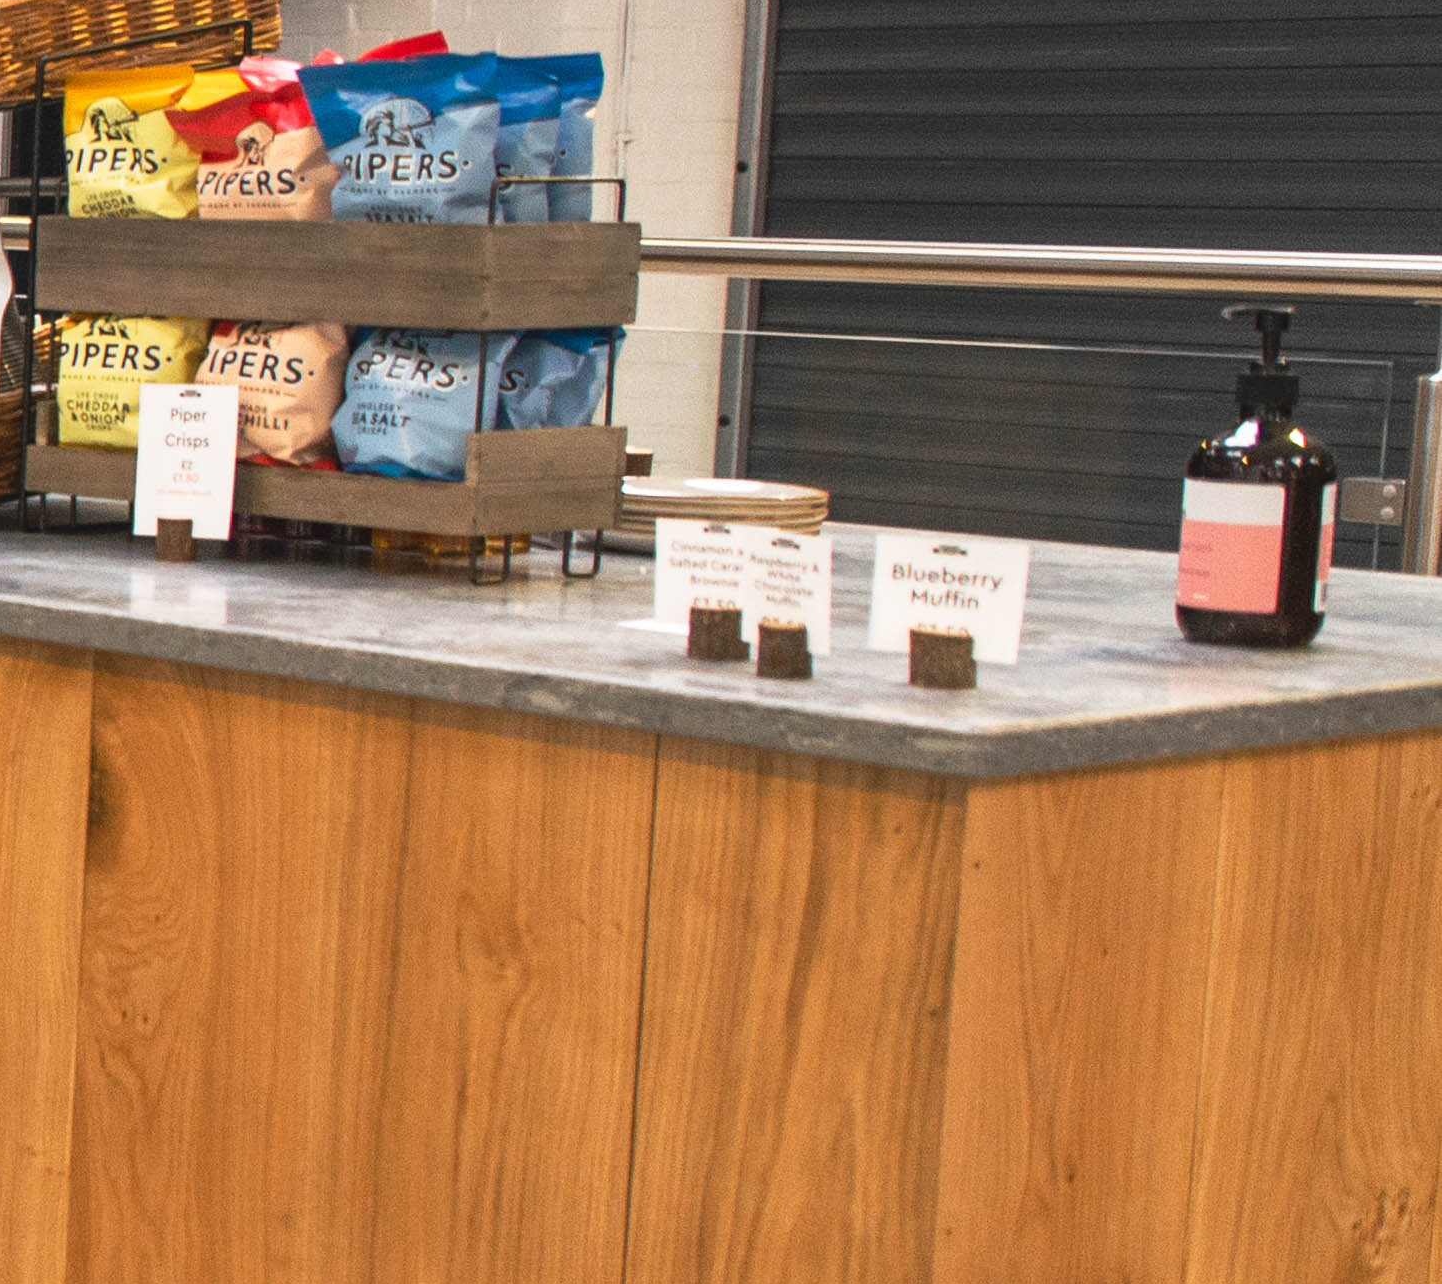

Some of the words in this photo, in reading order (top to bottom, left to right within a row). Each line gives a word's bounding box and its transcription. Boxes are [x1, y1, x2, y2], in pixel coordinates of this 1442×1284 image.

[200, 168, 297, 195] PIPERS
[209, 349, 304, 384] IPERS
[67, 400, 130, 414] CHEDDAR
[170, 407, 207, 424] Piper
[165, 432, 210, 450] Crisps
[181, 460, 193, 470] £2
[671, 541, 734, 556] Cinnamon
[670, 557, 708, 569] Salted
[711, 560, 743, 573] Cara
[750, 555, 807, 573] Raspberry
[690, 575, 740, 588] Brownie
[767, 570, 801, 583] White
[892, 563, 1003, 592] Blueberry
[754, 581, 814, 597] Chocolate
[911, 589, 980, 610] Muffin
